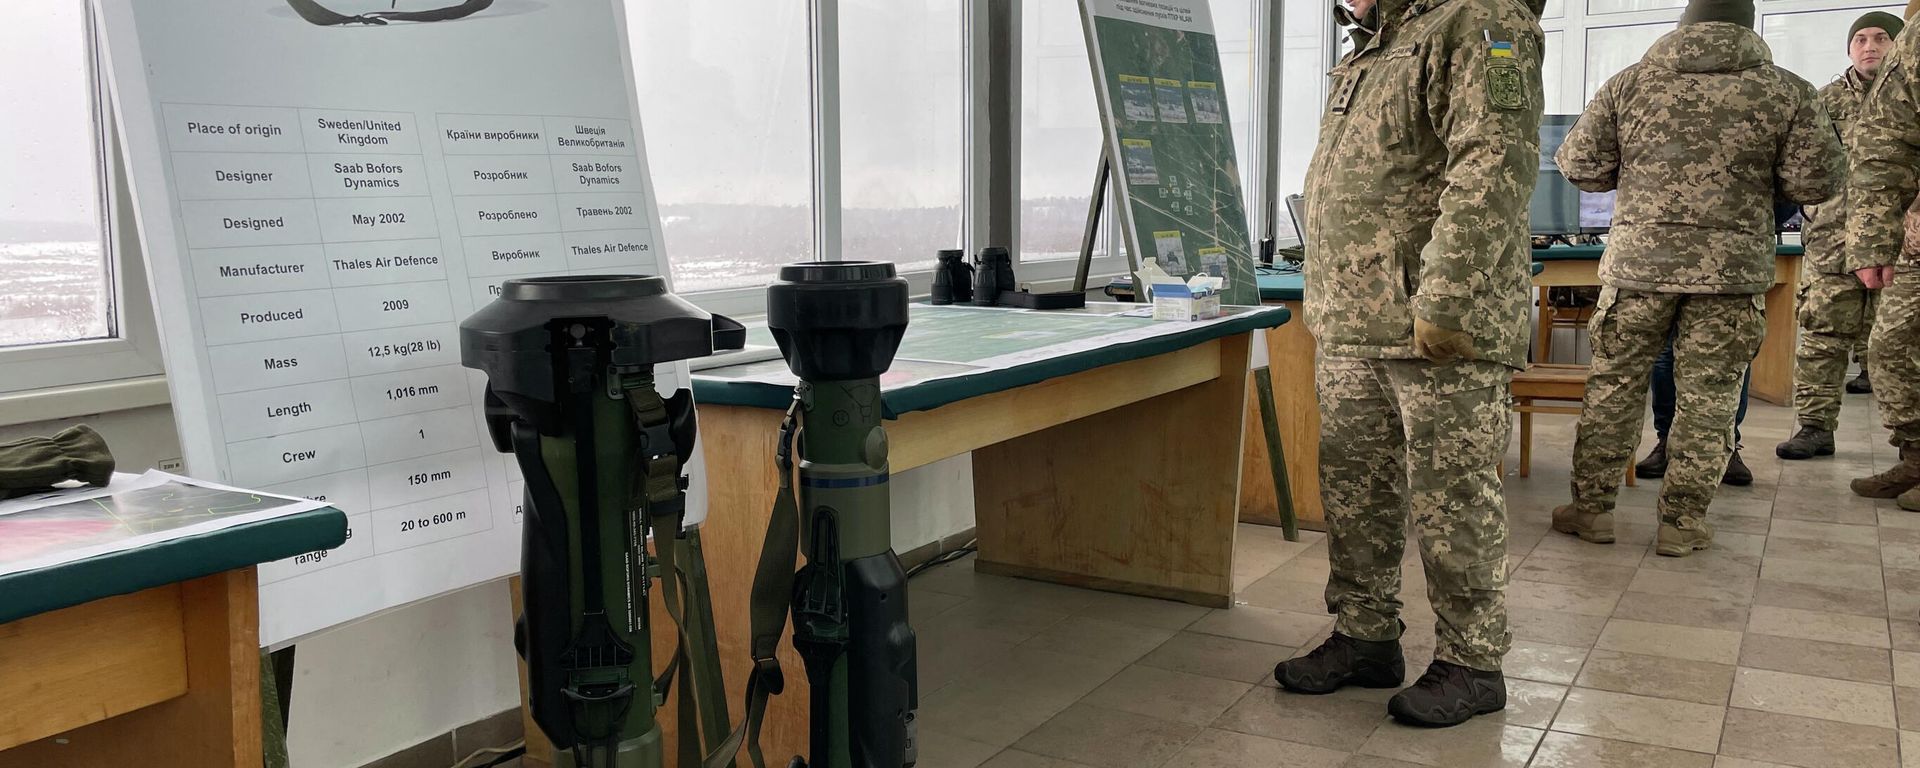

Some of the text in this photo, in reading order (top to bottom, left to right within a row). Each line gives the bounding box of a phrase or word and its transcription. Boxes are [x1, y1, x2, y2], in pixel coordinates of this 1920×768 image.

[188, 122, 281, 138] Place of origin
[318, 119, 401, 131] Sweden/United
[575, 125, 605, 136] Швеція
[338, 134, 388, 146] Kingdom
[447, 129, 539, 141] Країни виробники
[558, 138, 625, 149] Великобританія
[334, 164, 402, 174] Saab Bofors
[572, 163, 622, 173] Saab Bofors
[215, 171, 273, 183] Designer
[474, 170, 528, 181] Розробник
[580, 176, 619, 186] Dynamics
[344, 178, 399, 190] Dynamics
[479, 210, 537, 222] Розроблено
[576, 206, 632, 218] Травень 2002
[223, 217, 283, 230] Designed
[352, 214, 405, 226] May 2002
[572, 243, 648, 255] Thales Air Defence
[492, 250, 540, 262] Виробник
[333, 256, 438, 270] Thales Air Defence
[220, 263, 304, 277] Manufacturer
[383, 300, 409, 311] 2009
[241, 309, 303, 324] Produced
[368, 340, 441, 359] 12,5 kg(28 lb)
[264, 357, 298, 370] Mass
[386, 384, 438, 400] 1,016 mm
[267, 402, 312, 418] Length
[418, 429, 425, 439] 1
[282, 450, 316, 463] Crew
[408, 469, 451, 486] 150 mm
[401, 511, 466, 532] 20 to 600 m
[295, 549, 328, 565] range
